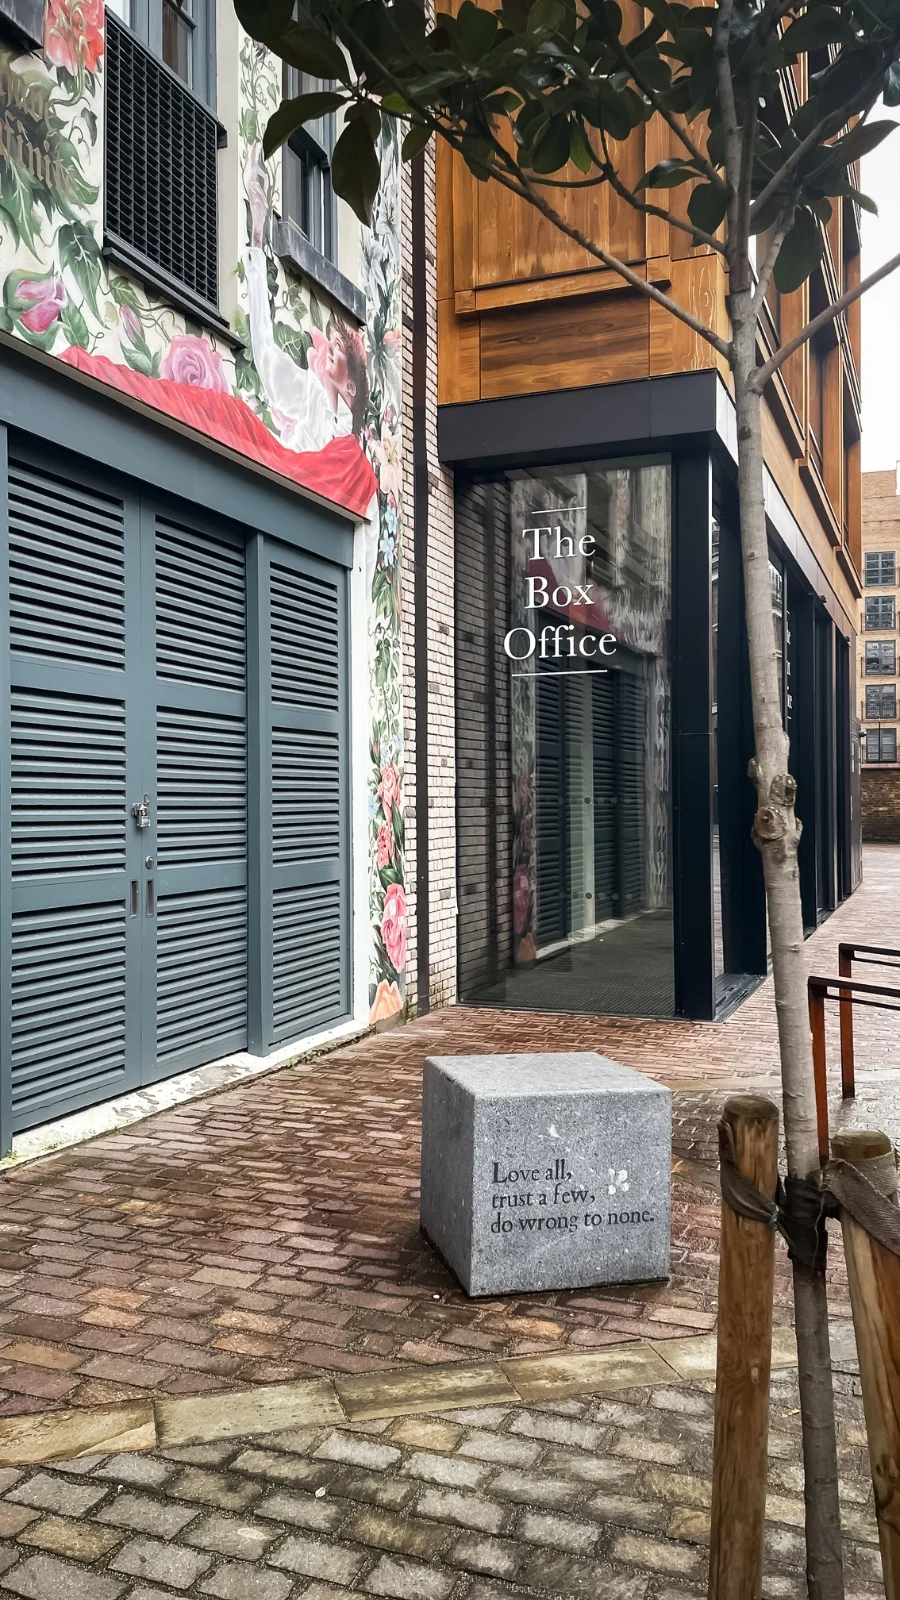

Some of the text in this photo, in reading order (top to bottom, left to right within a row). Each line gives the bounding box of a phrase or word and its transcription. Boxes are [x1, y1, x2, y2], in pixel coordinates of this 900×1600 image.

[522, 526, 596, 561] The
[524, 576, 595, 609] Box
[503, 624, 617, 660] Office
[492, 1158, 572, 1184] Love all,
[492, 1182, 596, 1209] trust a few,
[490, 1209, 655, 1234] do wrong to none.
